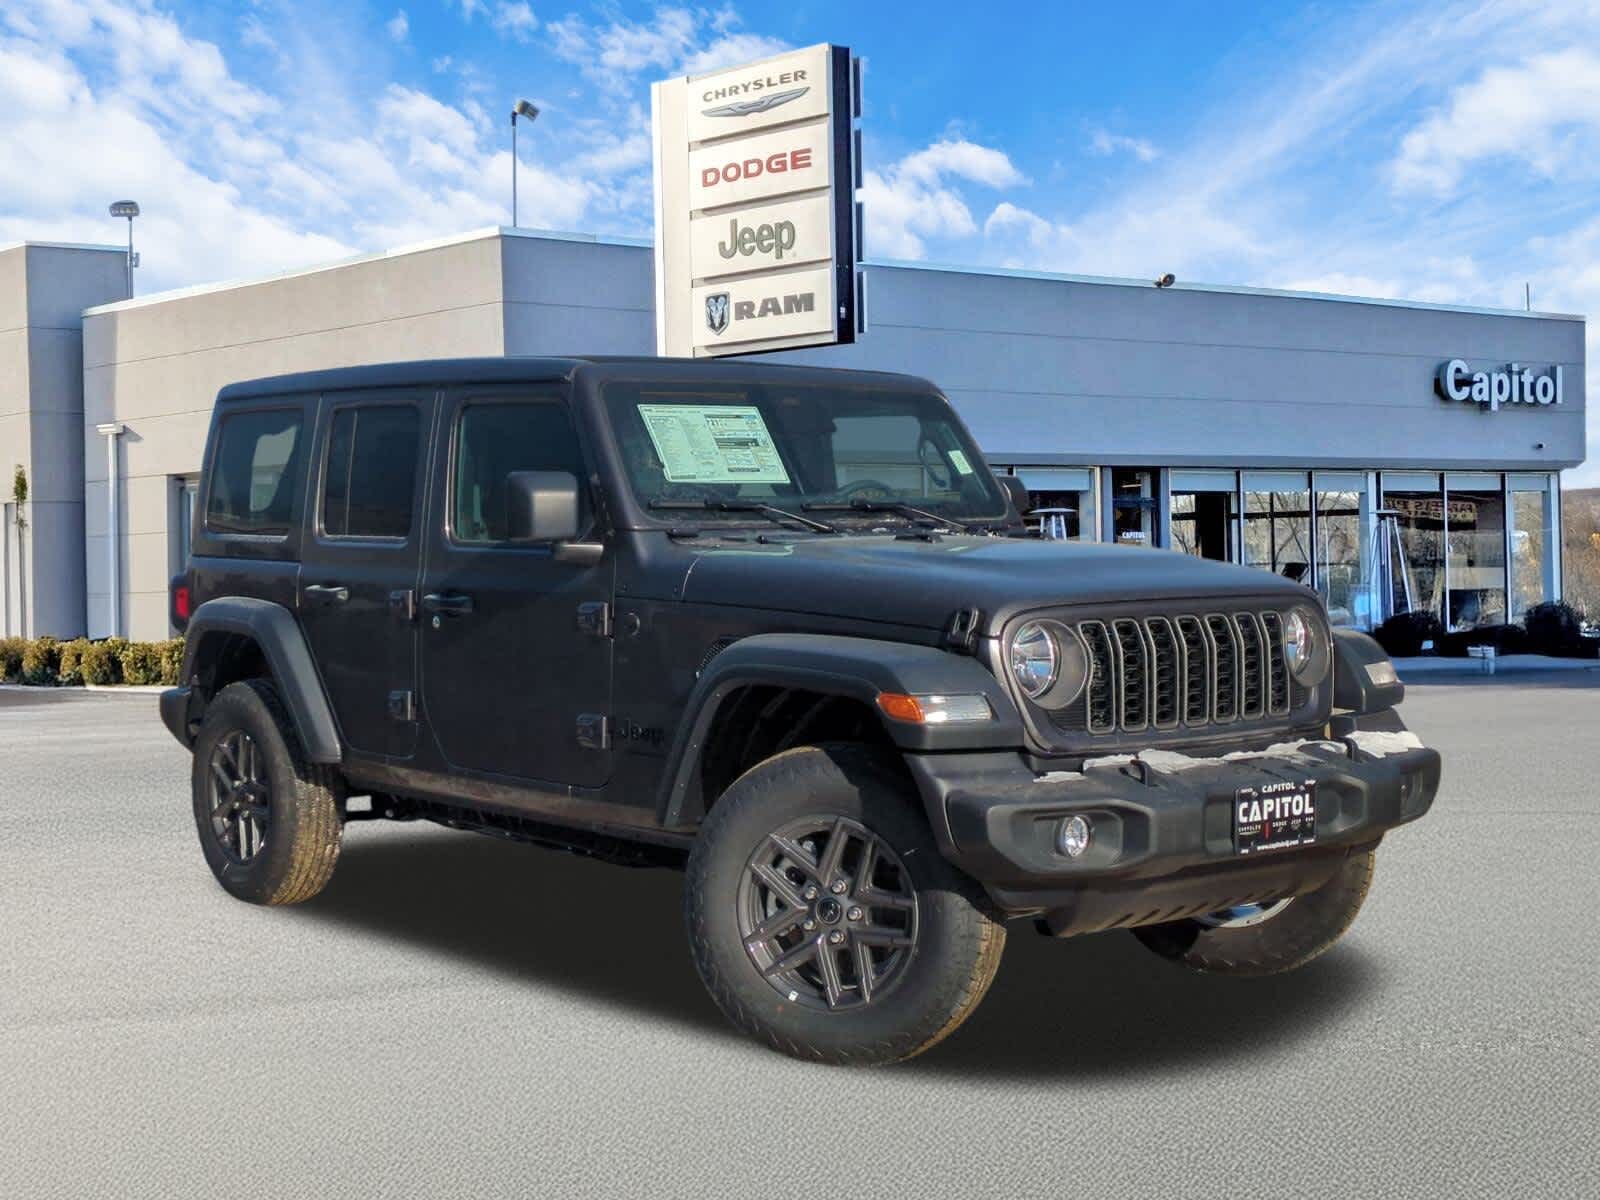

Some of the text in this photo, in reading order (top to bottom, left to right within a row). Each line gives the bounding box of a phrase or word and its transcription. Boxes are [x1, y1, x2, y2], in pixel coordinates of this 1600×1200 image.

[702, 69, 808, 102] CHRYSLER
[701, 148, 813, 188] DODGE
[718, 218, 796, 260] Jeep
[734, 292, 815, 321] RAM
[1445, 359, 1563, 411] Capitol
[1262, 782, 1296, 793] CAPITOL
[1238, 793, 1314, 823] CAPITOL
